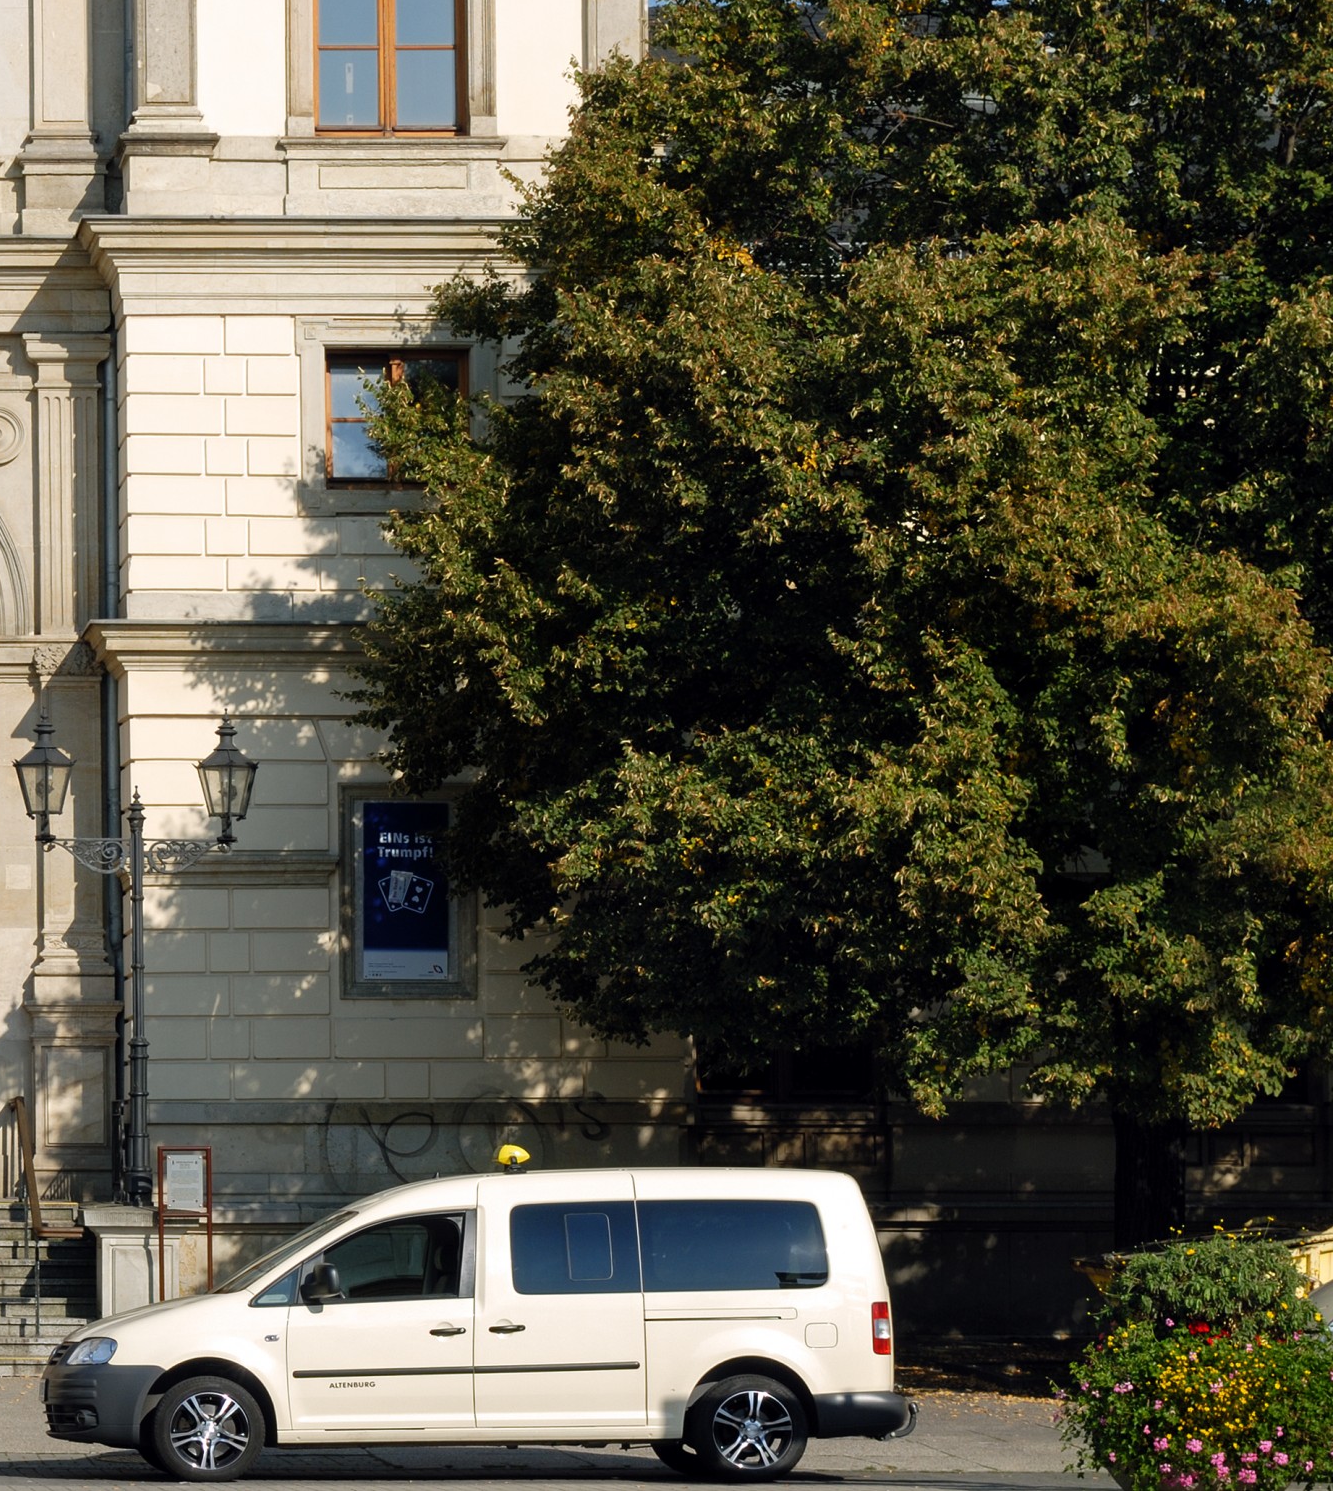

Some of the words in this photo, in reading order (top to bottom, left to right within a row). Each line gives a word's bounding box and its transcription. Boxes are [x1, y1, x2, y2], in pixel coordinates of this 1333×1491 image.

[379, 832, 410, 844] EINs
[377, 846, 433, 861] Trumpf!
[328, 1381, 376, 1389] ALTENBURG
